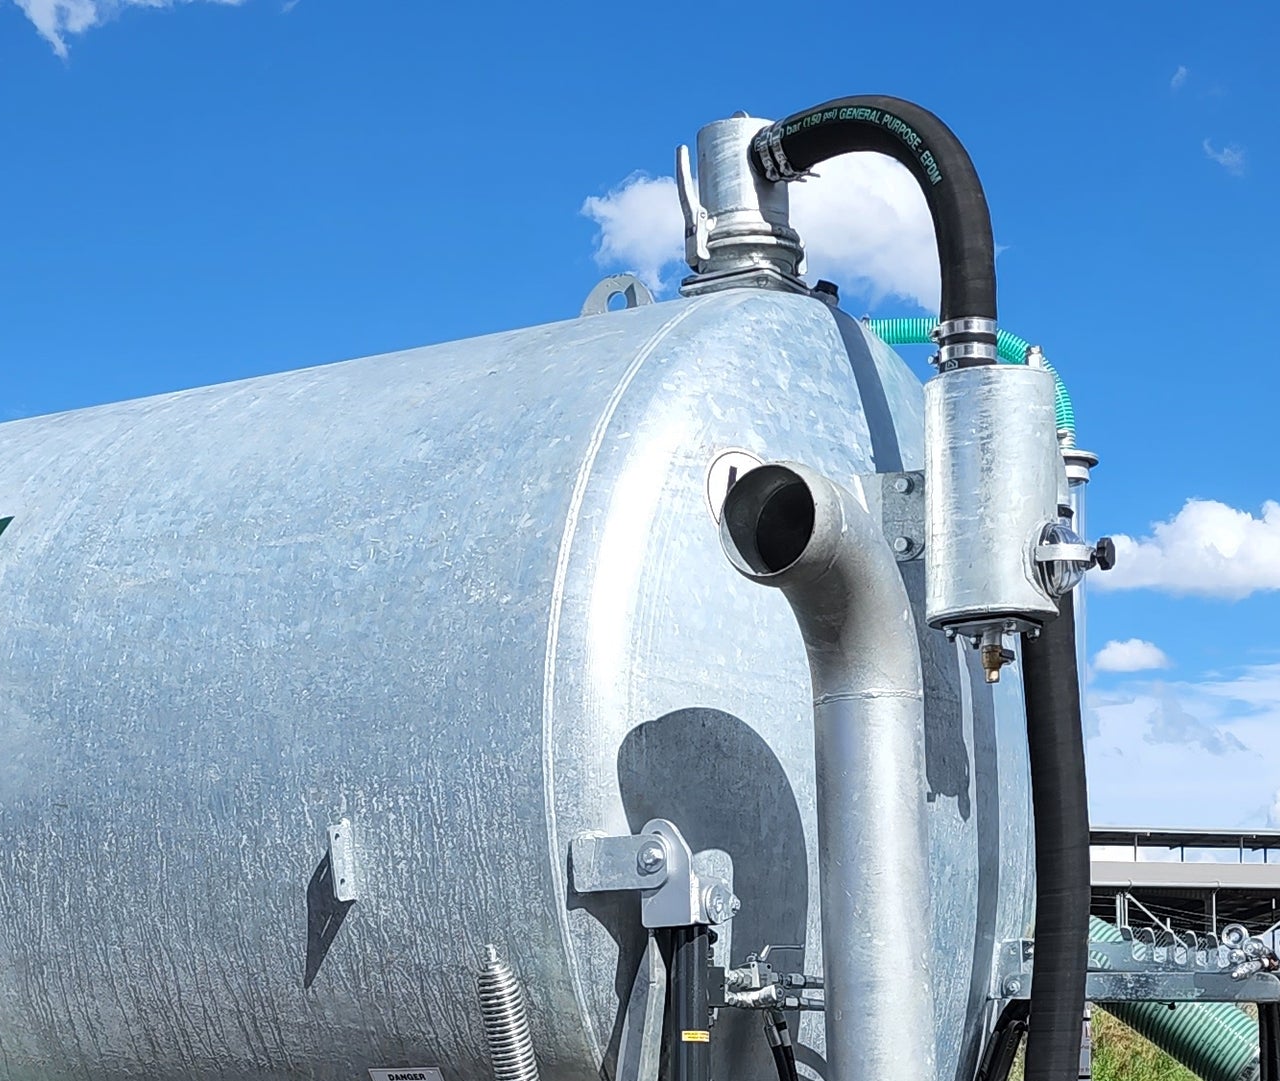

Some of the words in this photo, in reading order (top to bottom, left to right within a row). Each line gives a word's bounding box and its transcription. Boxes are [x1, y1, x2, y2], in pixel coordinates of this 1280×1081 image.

[786, 121, 802, 136] bar
[839, 107, 881, 125] GENERAL
[881, 114, 922, 151] PURPOSE
[920, 150, 943, 186] EPDM
[387, 1073, 427, 1081] DANGER
